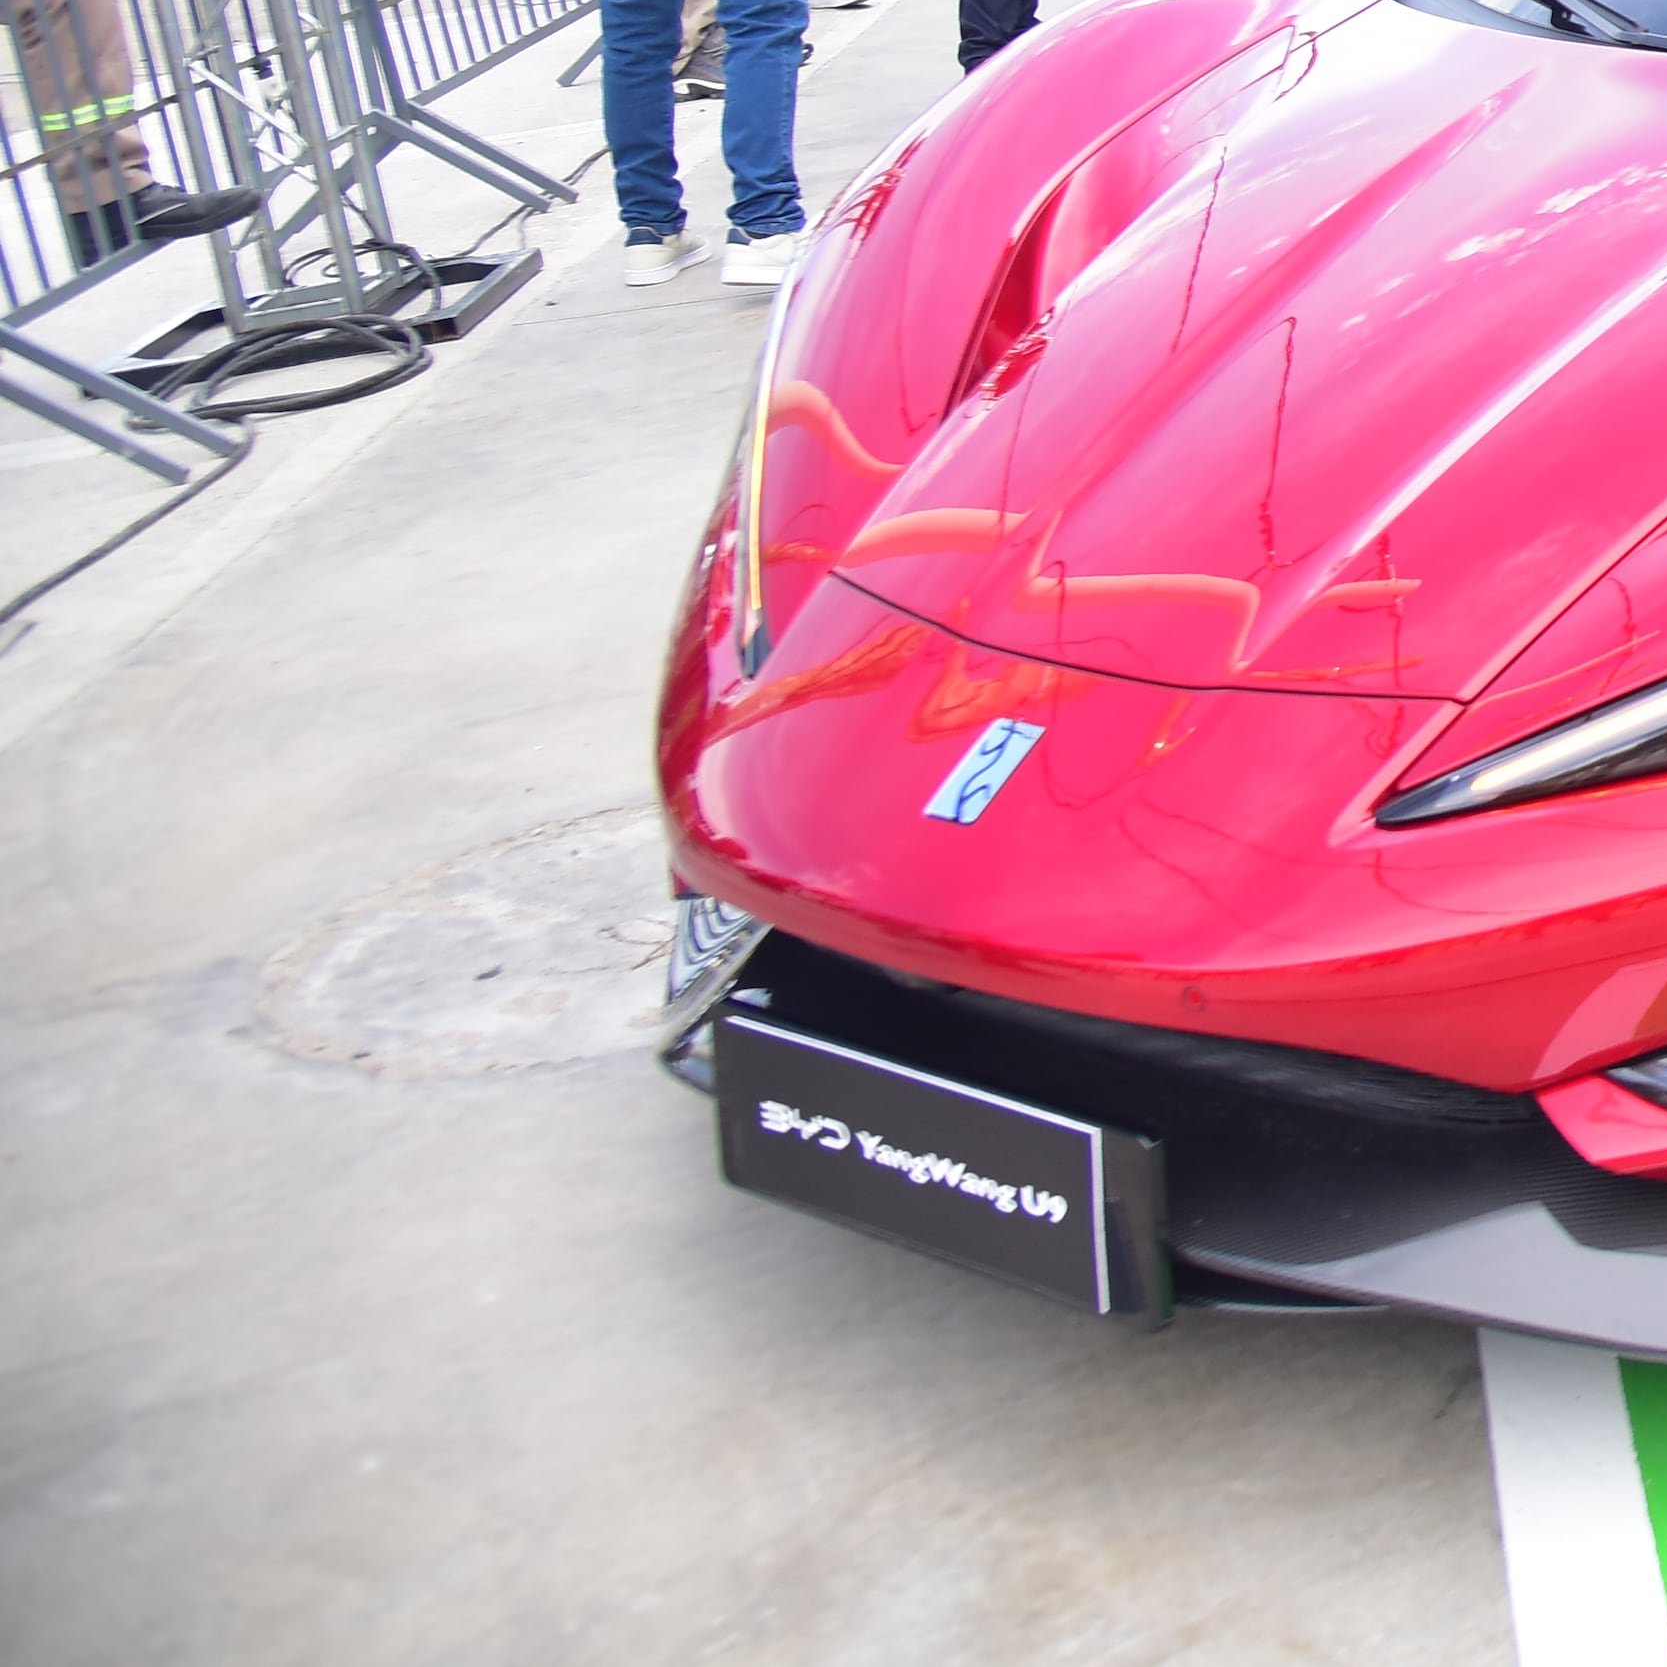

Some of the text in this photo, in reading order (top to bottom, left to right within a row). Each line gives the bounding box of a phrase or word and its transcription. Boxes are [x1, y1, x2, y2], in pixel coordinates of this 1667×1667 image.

[759, 1100, 1068, 1223] BYD YangWang U9
